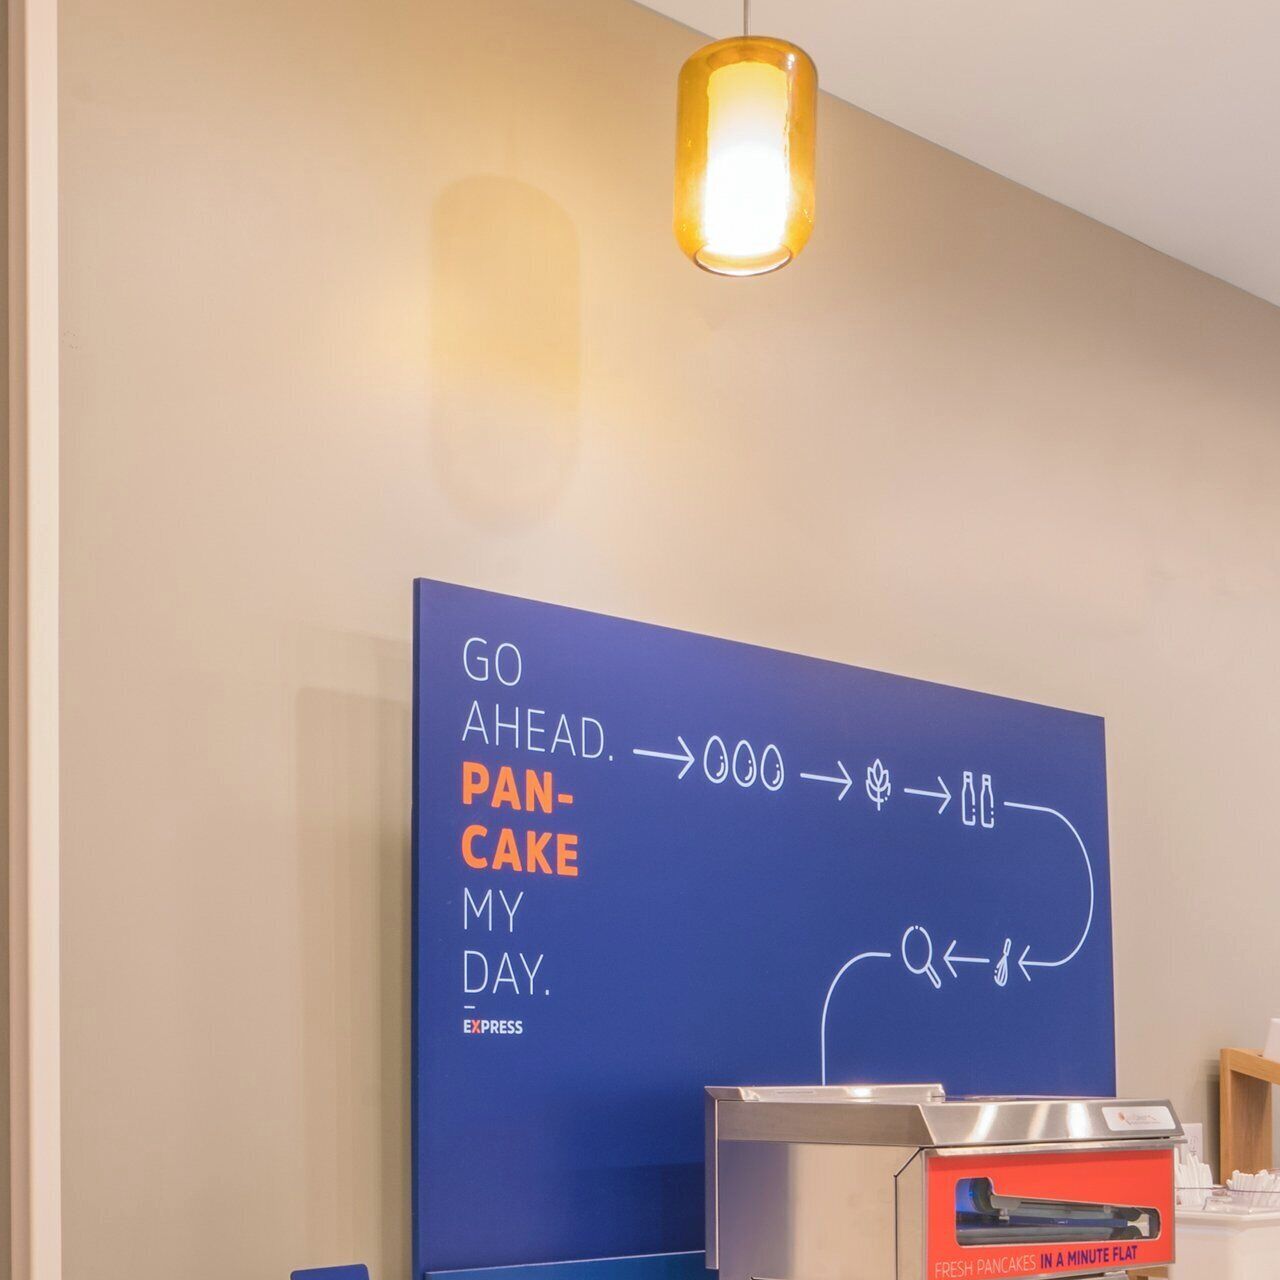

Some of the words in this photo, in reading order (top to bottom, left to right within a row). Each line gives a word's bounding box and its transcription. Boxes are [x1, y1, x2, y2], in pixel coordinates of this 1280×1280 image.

[462, 637, 522, 686] GO
[461, 700, 614, 762] AHEAD.
[461, 761, 574, 814] PAN-
[461, 824, 580, 877] CAKE
[463, 887, 524, 932] MY
[463, 950, 550, 996] DAY.
[463, 1019, 523, 1034] EXPRESS
[935, 1261, 973, 1278] FRESH
[977, 1254, 1036, 1274] PANCAKES
[1040, 1254, 1053, 1269] IN
[1056, 1252, 1064, 1267] A
[1067, 1247, 1110, 1265] MINUTE
[1112, 1245, 1138, 1262] FLAT
